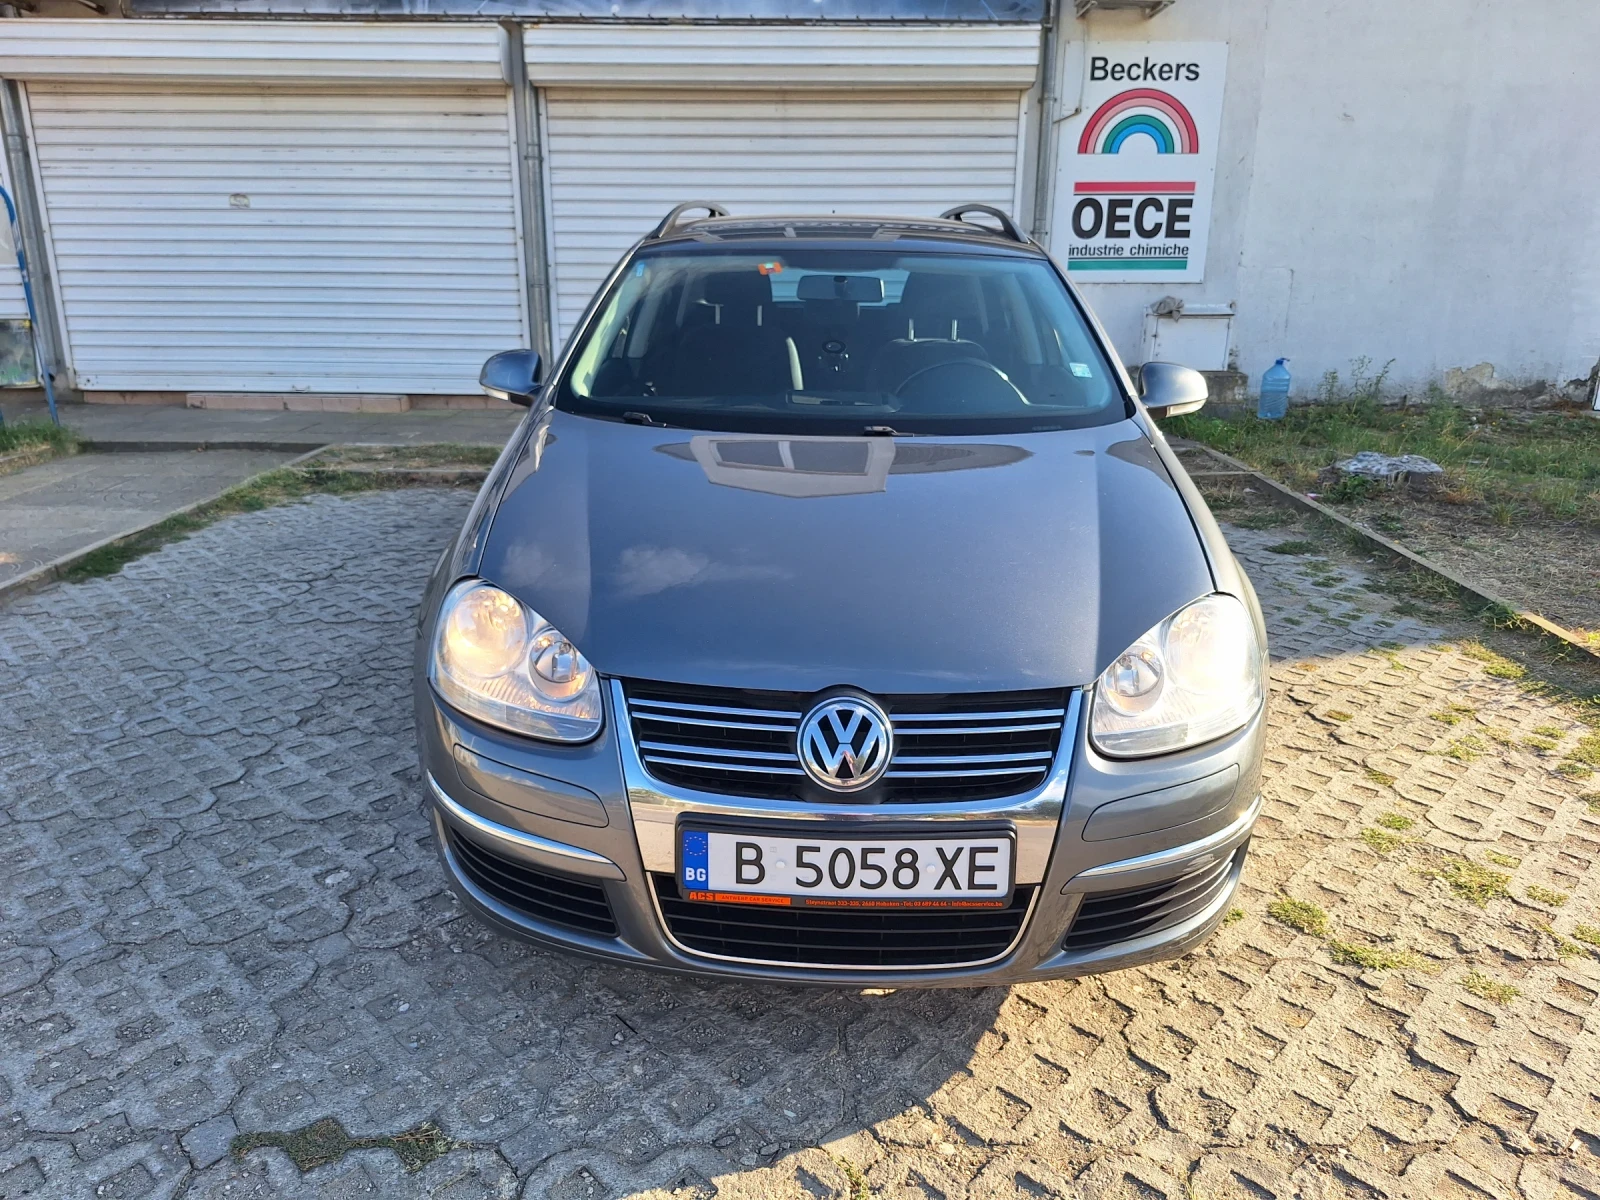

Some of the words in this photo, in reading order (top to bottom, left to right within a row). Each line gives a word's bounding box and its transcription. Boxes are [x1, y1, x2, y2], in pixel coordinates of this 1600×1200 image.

[1090, 56, 1200, 81] Beckers
[1072, 197, 1194, 239] OECE
[1068, 244, 1124, 256] industrie
[1129, 244, 1189, 256] chimiche
[685, 867, 707, 881] BG
[735, 841, 766, 885] B
[795, 845, 920, 890] 5058
[933, 846, 999, 890] XE
[689, 891, 714, 901] ACS
